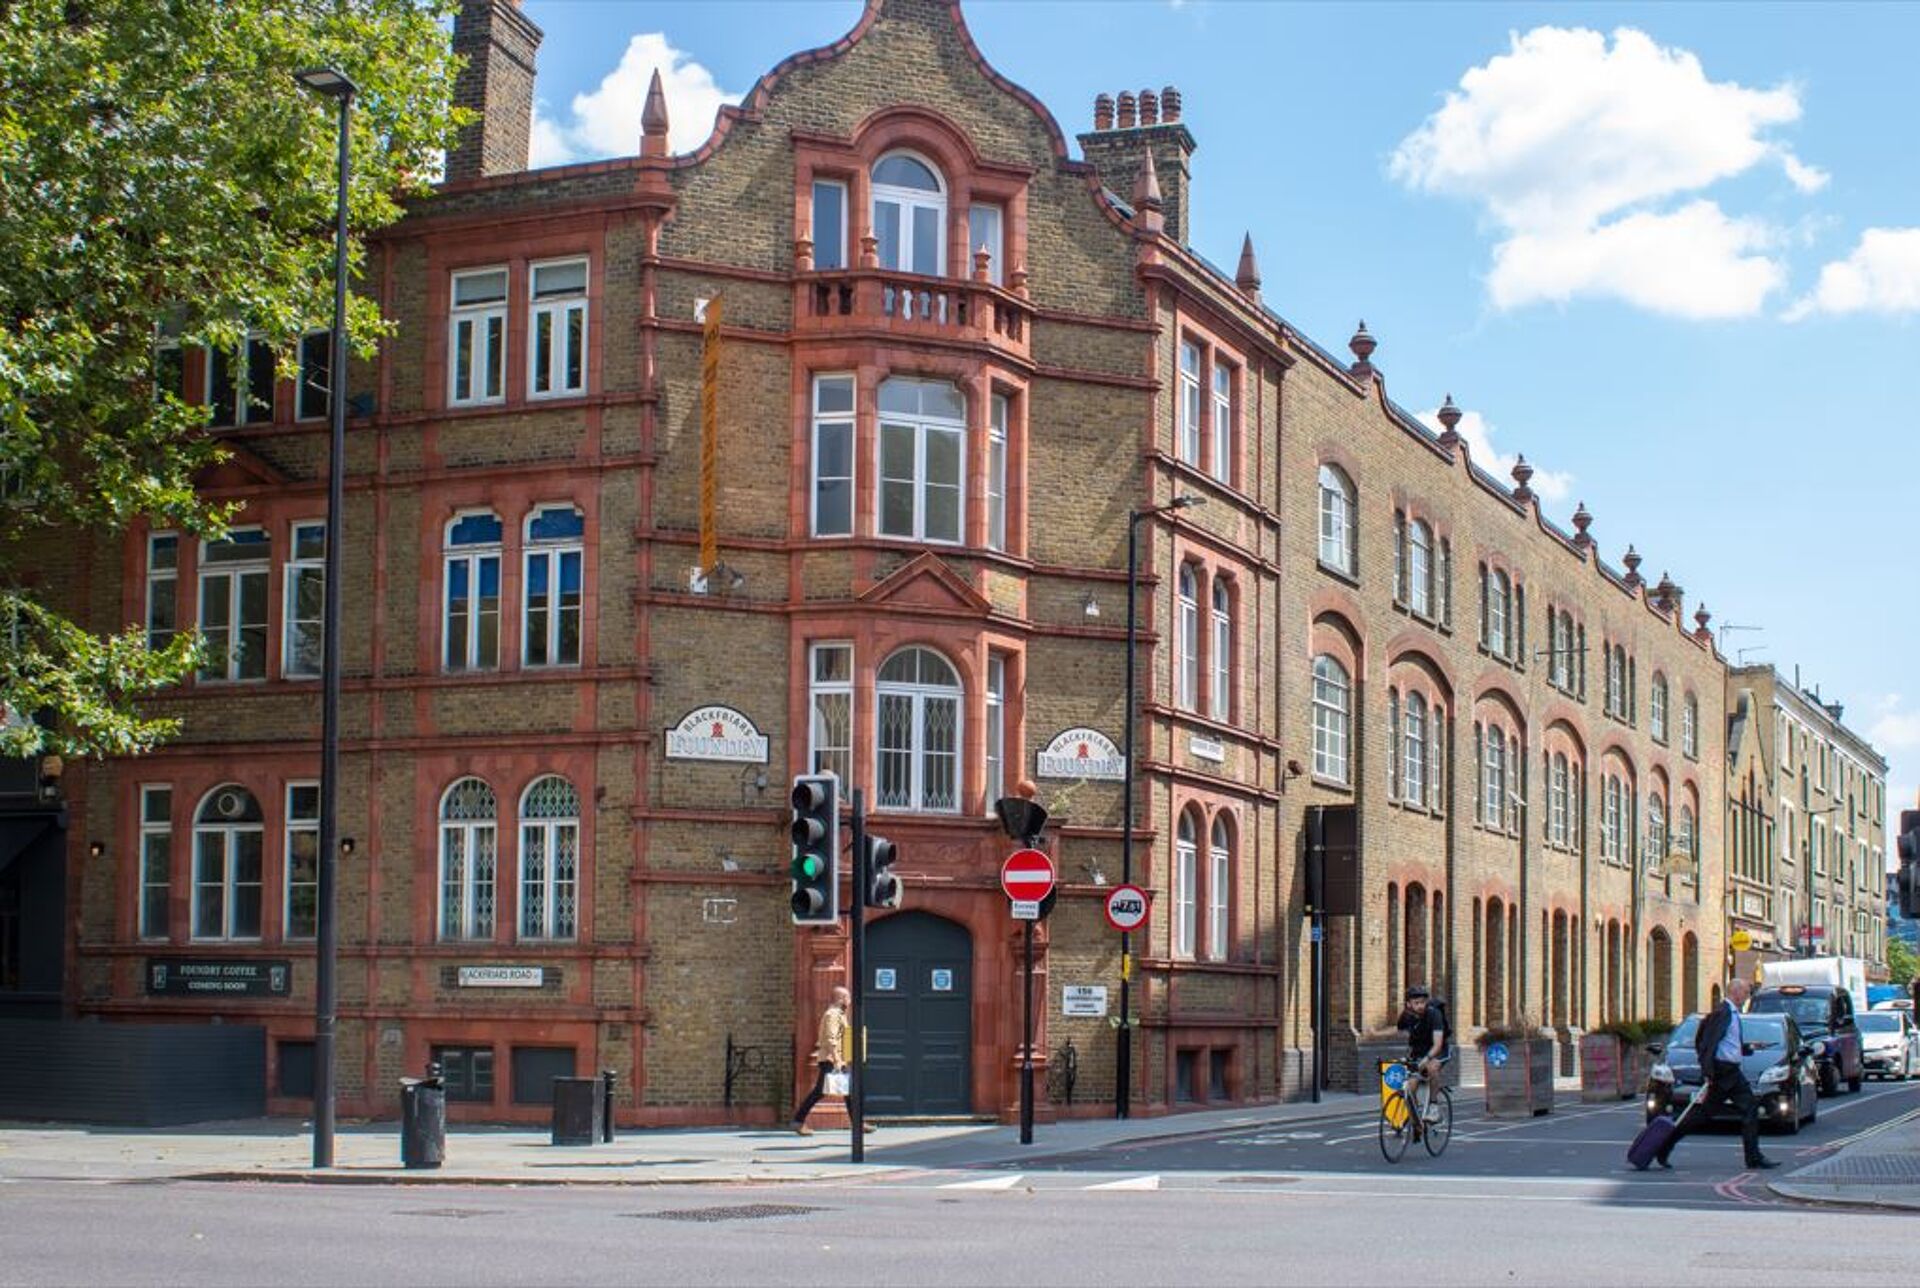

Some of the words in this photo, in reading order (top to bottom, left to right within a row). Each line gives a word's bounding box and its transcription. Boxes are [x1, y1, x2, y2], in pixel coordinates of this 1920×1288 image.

[682, 711, 753, 736] BLACKFRIARS
[670, 735, 765, 758] FOUNDRY
[1052, 733, 1116, 756] BLACKFRIARS
[223, 982, 247, 990] SOON
[510, 970, 533, 979] ROAD
